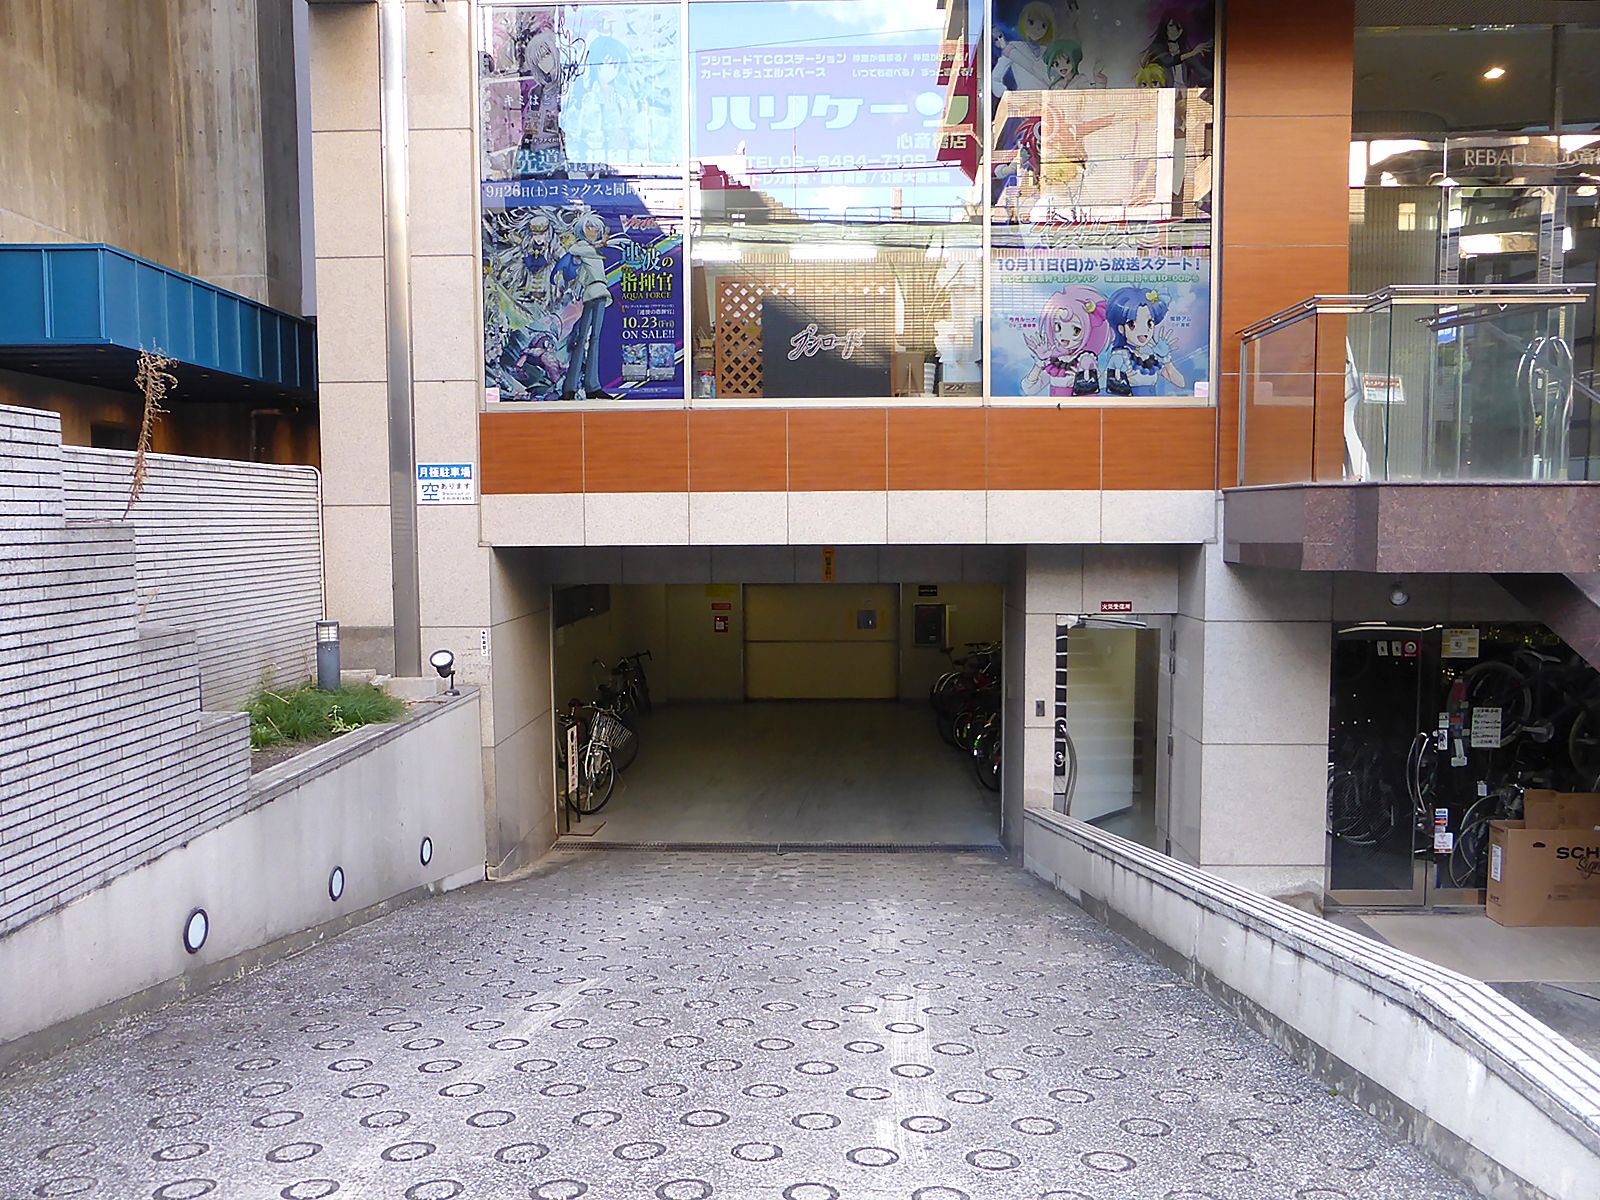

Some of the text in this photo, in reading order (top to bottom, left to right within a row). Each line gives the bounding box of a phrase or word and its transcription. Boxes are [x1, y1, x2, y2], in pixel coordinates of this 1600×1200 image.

[705, 91, 969, 131] ハリケーン
[622, 329, 675, 340] ON SALE!!
[421, 482, 440, 502] 空
